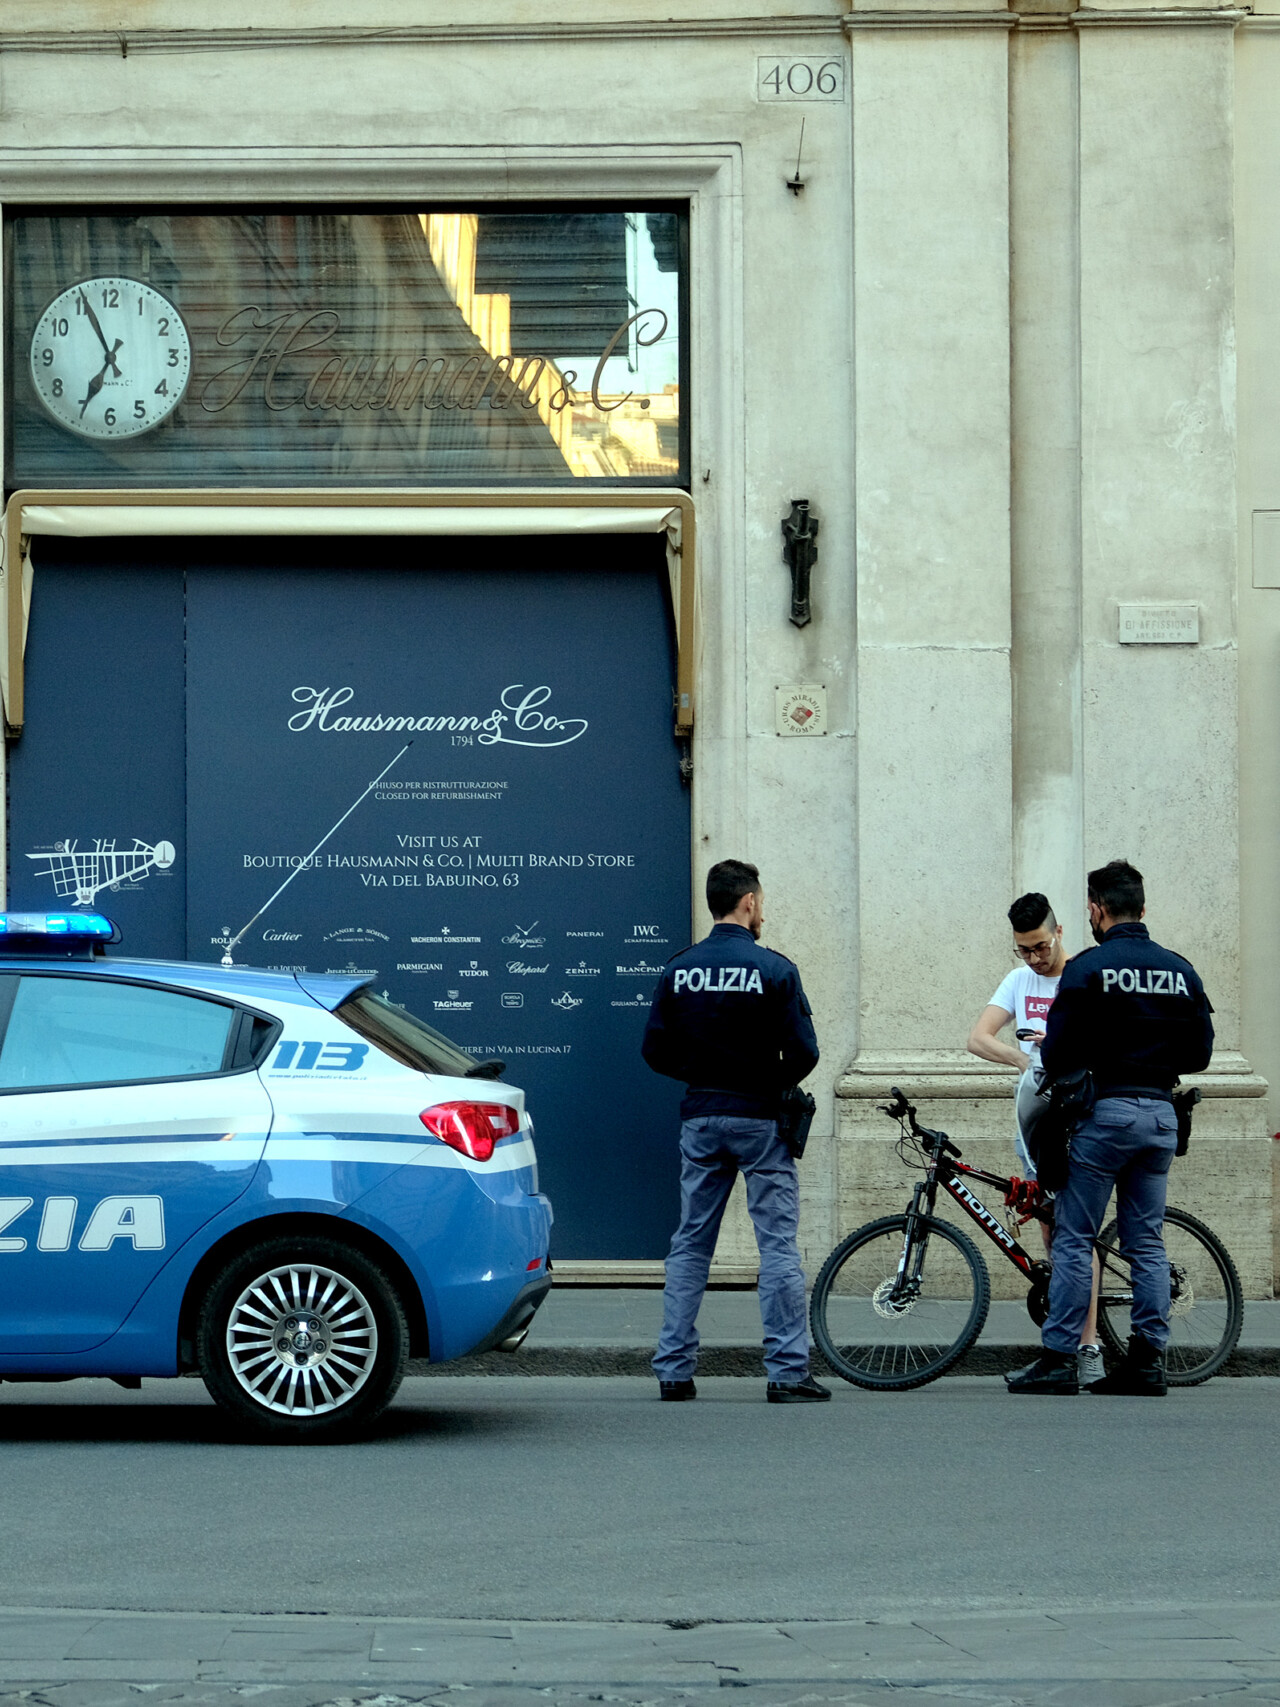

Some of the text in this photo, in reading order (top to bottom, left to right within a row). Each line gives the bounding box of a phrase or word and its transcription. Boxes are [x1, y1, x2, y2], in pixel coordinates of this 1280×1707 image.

[761, 61, 842, 95] 406
[102, 289, 119, 308] 12
[137, 297, 144, 316] 1
[51, 318, 69, 337] 10
[157, 317, 170, 337] 2
[42, 348, 54, 367] 9
[167, 348, 180, 367] 3
[200, 304, 542, 413] Hausmann
[549, 370, 577, 415] &
[52, 378, 64, 398] 8
[154, 378, 169, 398] 4
[104, 407, 117, 427] 6
[133, 400, 146, 419] 5
[1139, 620, 1193, 630] AFFISSIONE
[287, 686, 484, 732] Hausmann
[450, 735, 474, 747] 1794
[405, 781, 421, 789] PER
[423, 781, 508, 789] RISTRUTTURAZIONE
[375, 792, 503, 800] CLOSED FOR REFURBISHMENT
[397, 834, 482, 848] VISIT US AT
[243, 854, 323, 871] BOUTIQUE
[328, 854, 418, 868] HAUSMANN
[422, 854, 435, 868] &
[437, 854, 464, 868] CO.
[477, 854, 523, 868] MULTI
[529, 854, 583, 868] BRAND
[587, 854, 635, 868] STORE
[360, 873, 520, 888] VIA DEL BABUINO, 63
[262, 929, 303, 942] Cartier
[633, 926, 660, 937] IWC
[396, 963, 443, 971] PARMIGIANI
[506, 961, 550, 976] Chopard
[673, 967, 764, 994] POLIZIA
[1102, 968, 1189, 997] POLIZIA
[271, 1040, 370, 1072] 113
[497, 1045, 513, 1053] VIA
[527, 1045, 561, 1053] LUCINA
